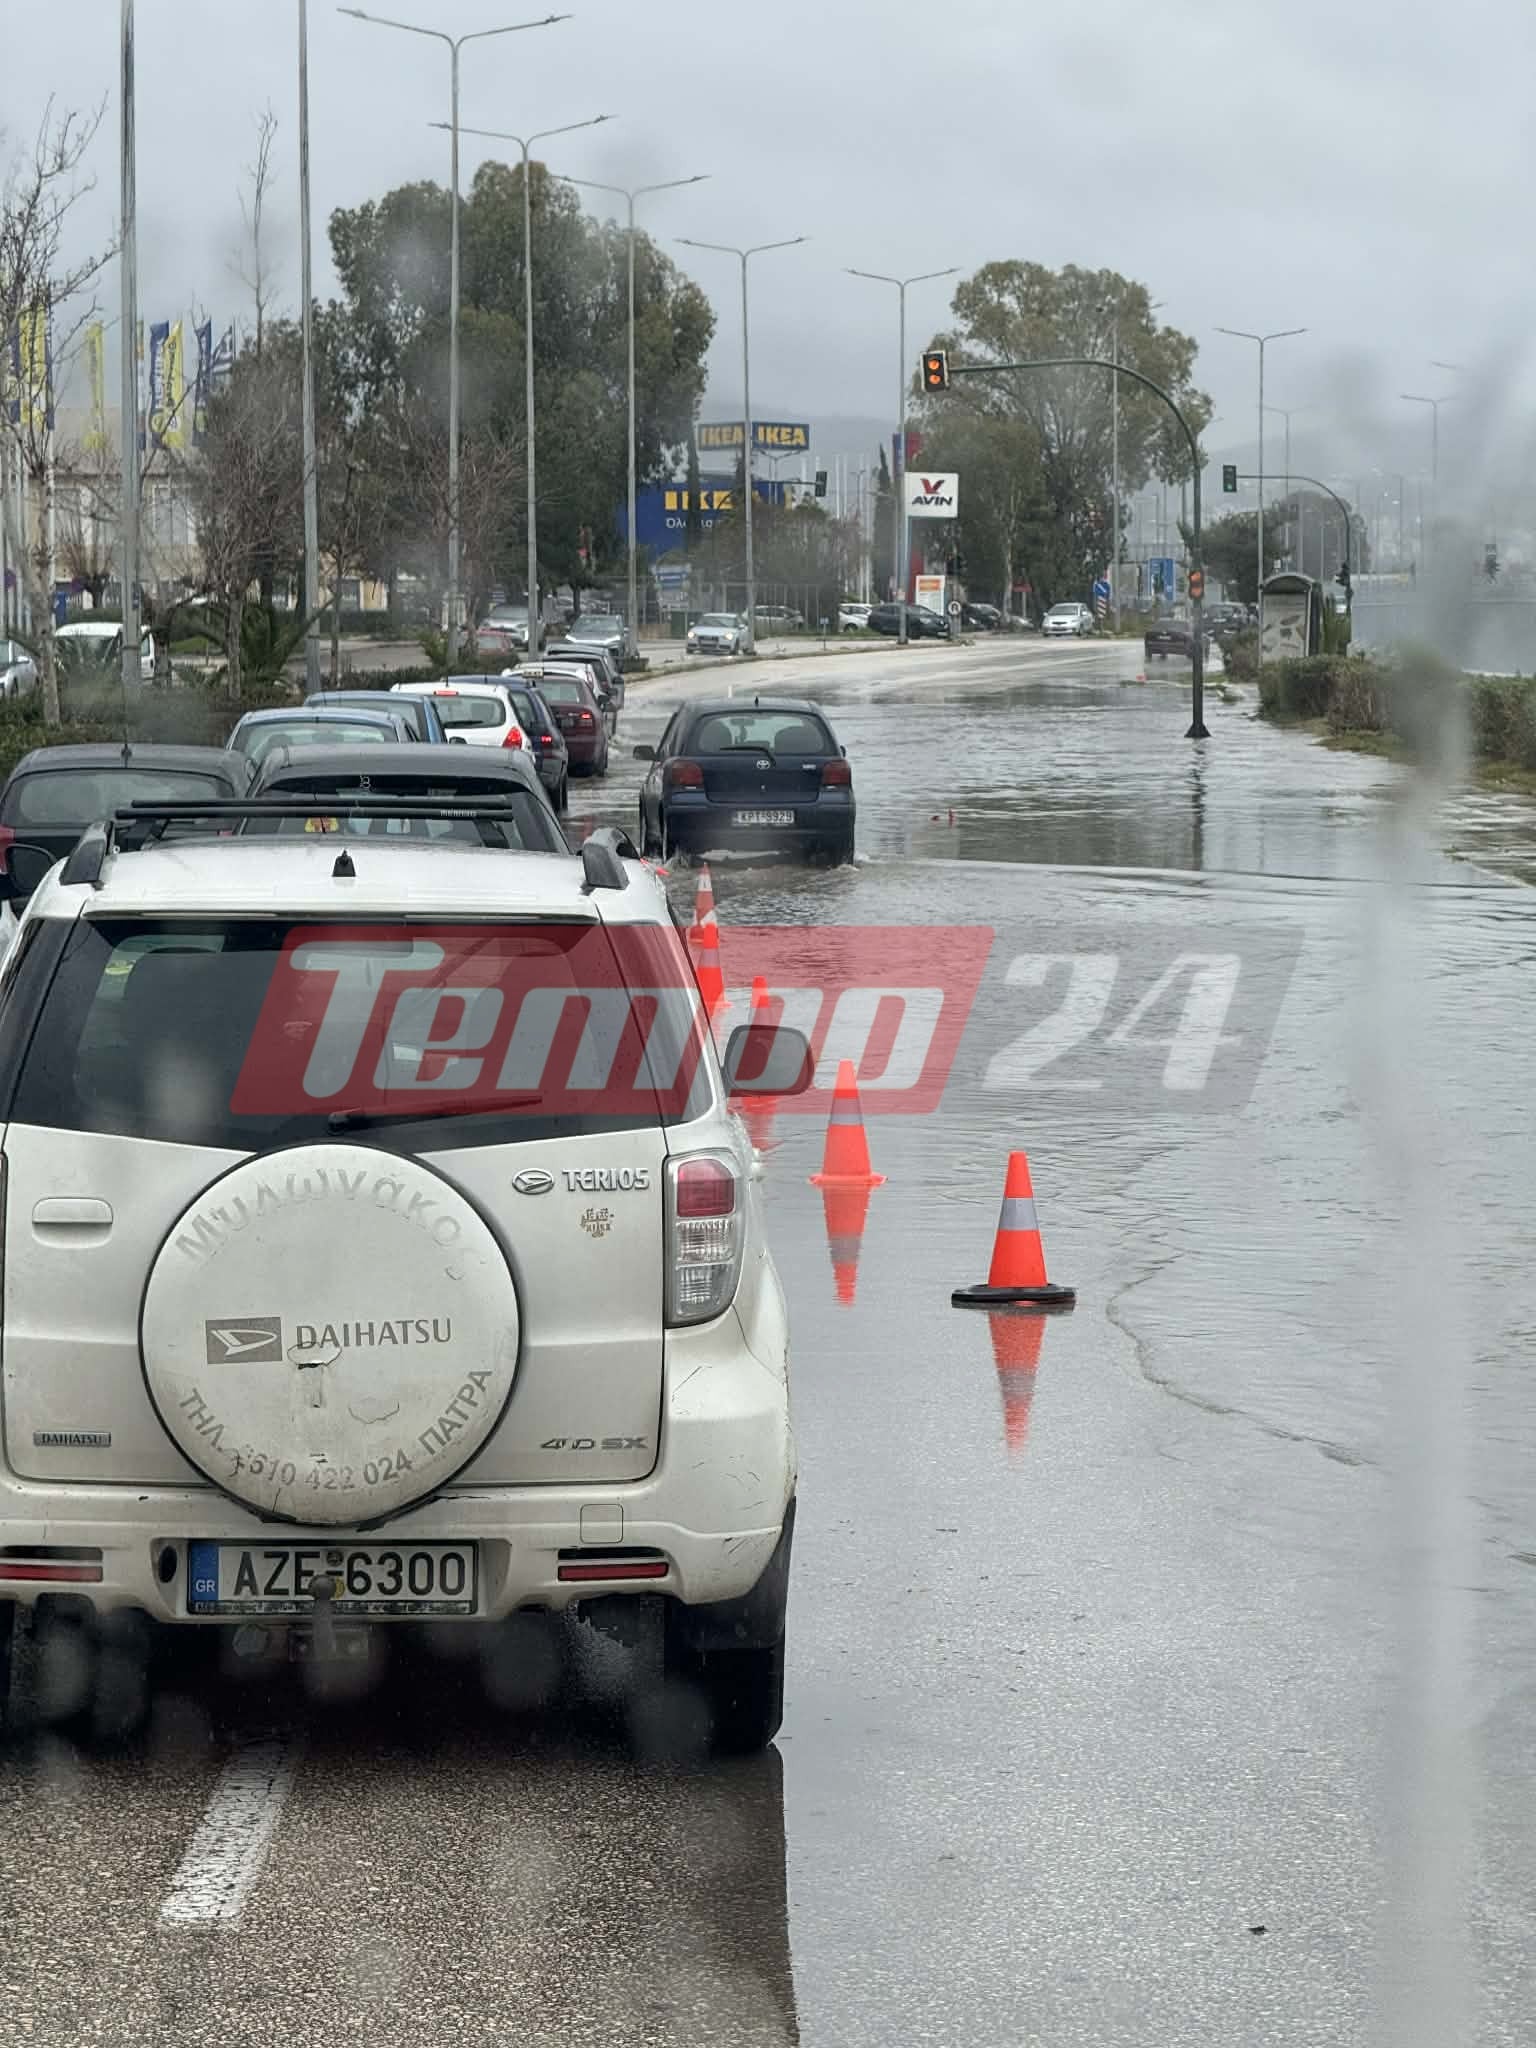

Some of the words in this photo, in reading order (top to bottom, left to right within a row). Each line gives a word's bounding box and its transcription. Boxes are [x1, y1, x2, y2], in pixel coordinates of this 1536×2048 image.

[704, 425, 743, 445] IKEA
[758, 425, 806, 446] IKEA
[912, 496, 953, 506] AVIN
[562, 1167, 650, 1191] TERIOS
[295, 1318, 452, 1350] DAIHATSU
[363, 1449, 413, 1485] 024
[418, 1371, 493, 1455] ΠΑΤΡΑ
[42, 1433, 104, 1445] DAIHATSU
[195, 1579, 216, 1593] GR
